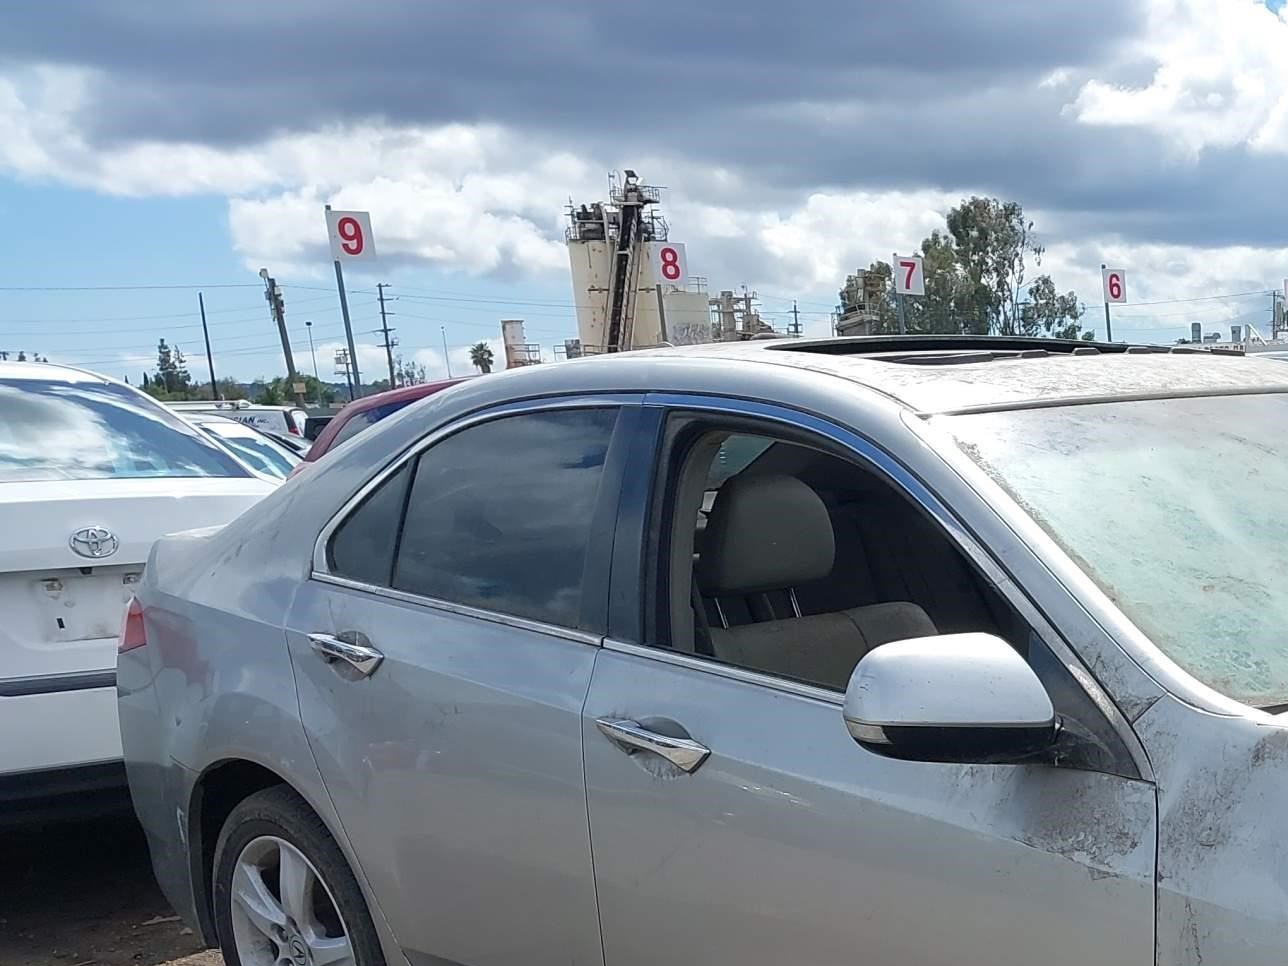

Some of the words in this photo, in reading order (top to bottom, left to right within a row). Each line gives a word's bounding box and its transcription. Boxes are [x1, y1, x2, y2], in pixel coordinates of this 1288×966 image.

[337, 216, 364, 255] 9
[660, 248, 680, 280] 8
[900, 261, 916, 289] 7
[1108, 273, 1121, 299] 6
